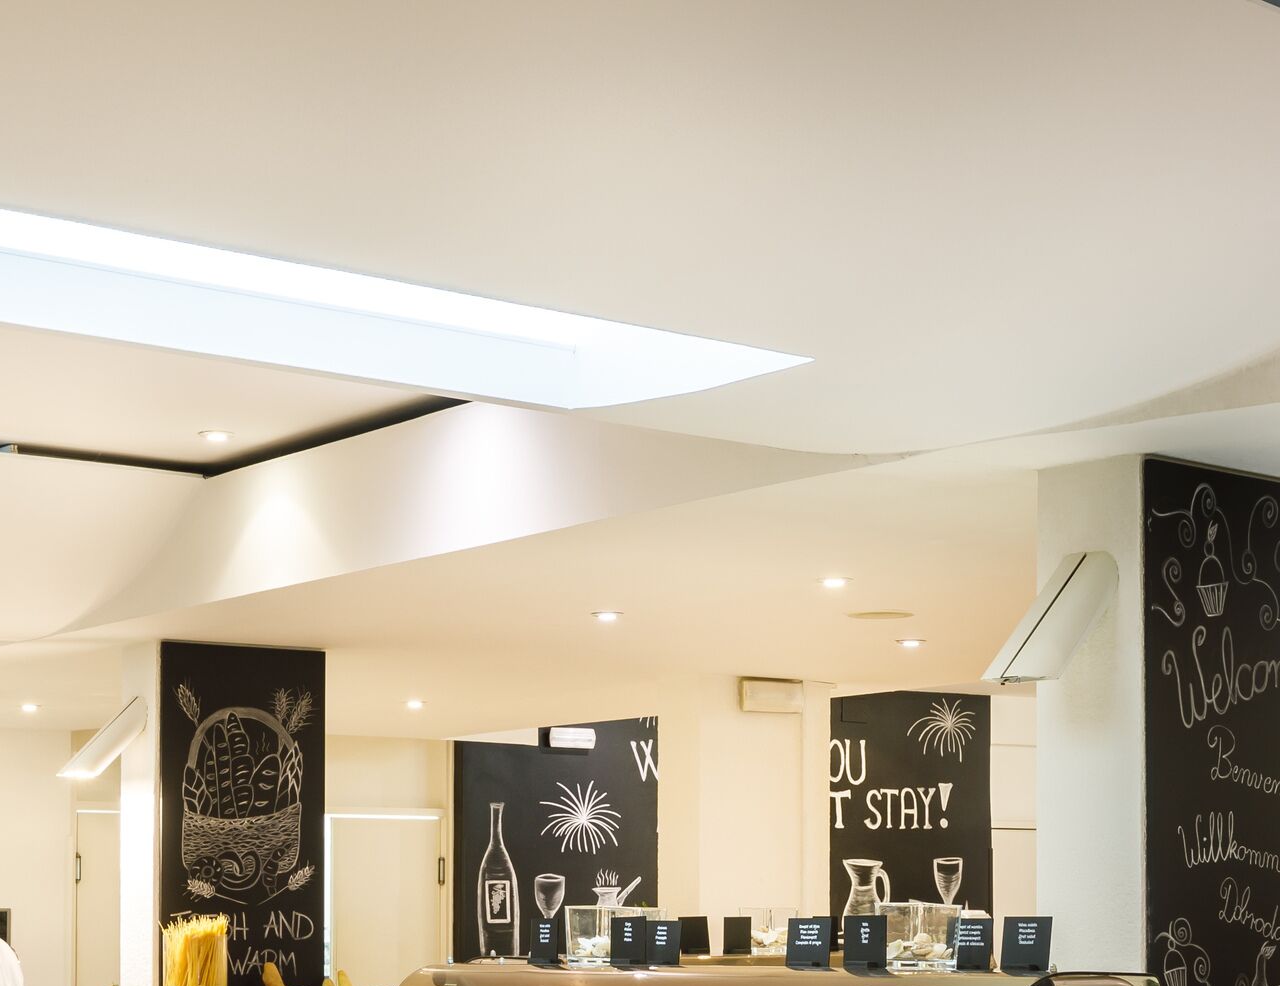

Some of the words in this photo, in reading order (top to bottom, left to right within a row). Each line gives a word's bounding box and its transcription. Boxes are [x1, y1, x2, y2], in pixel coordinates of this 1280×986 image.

[829, 738, 867, 785] OU
[863, 782, 954, 830] STAY!
[263, 910, 315, 941] AND
